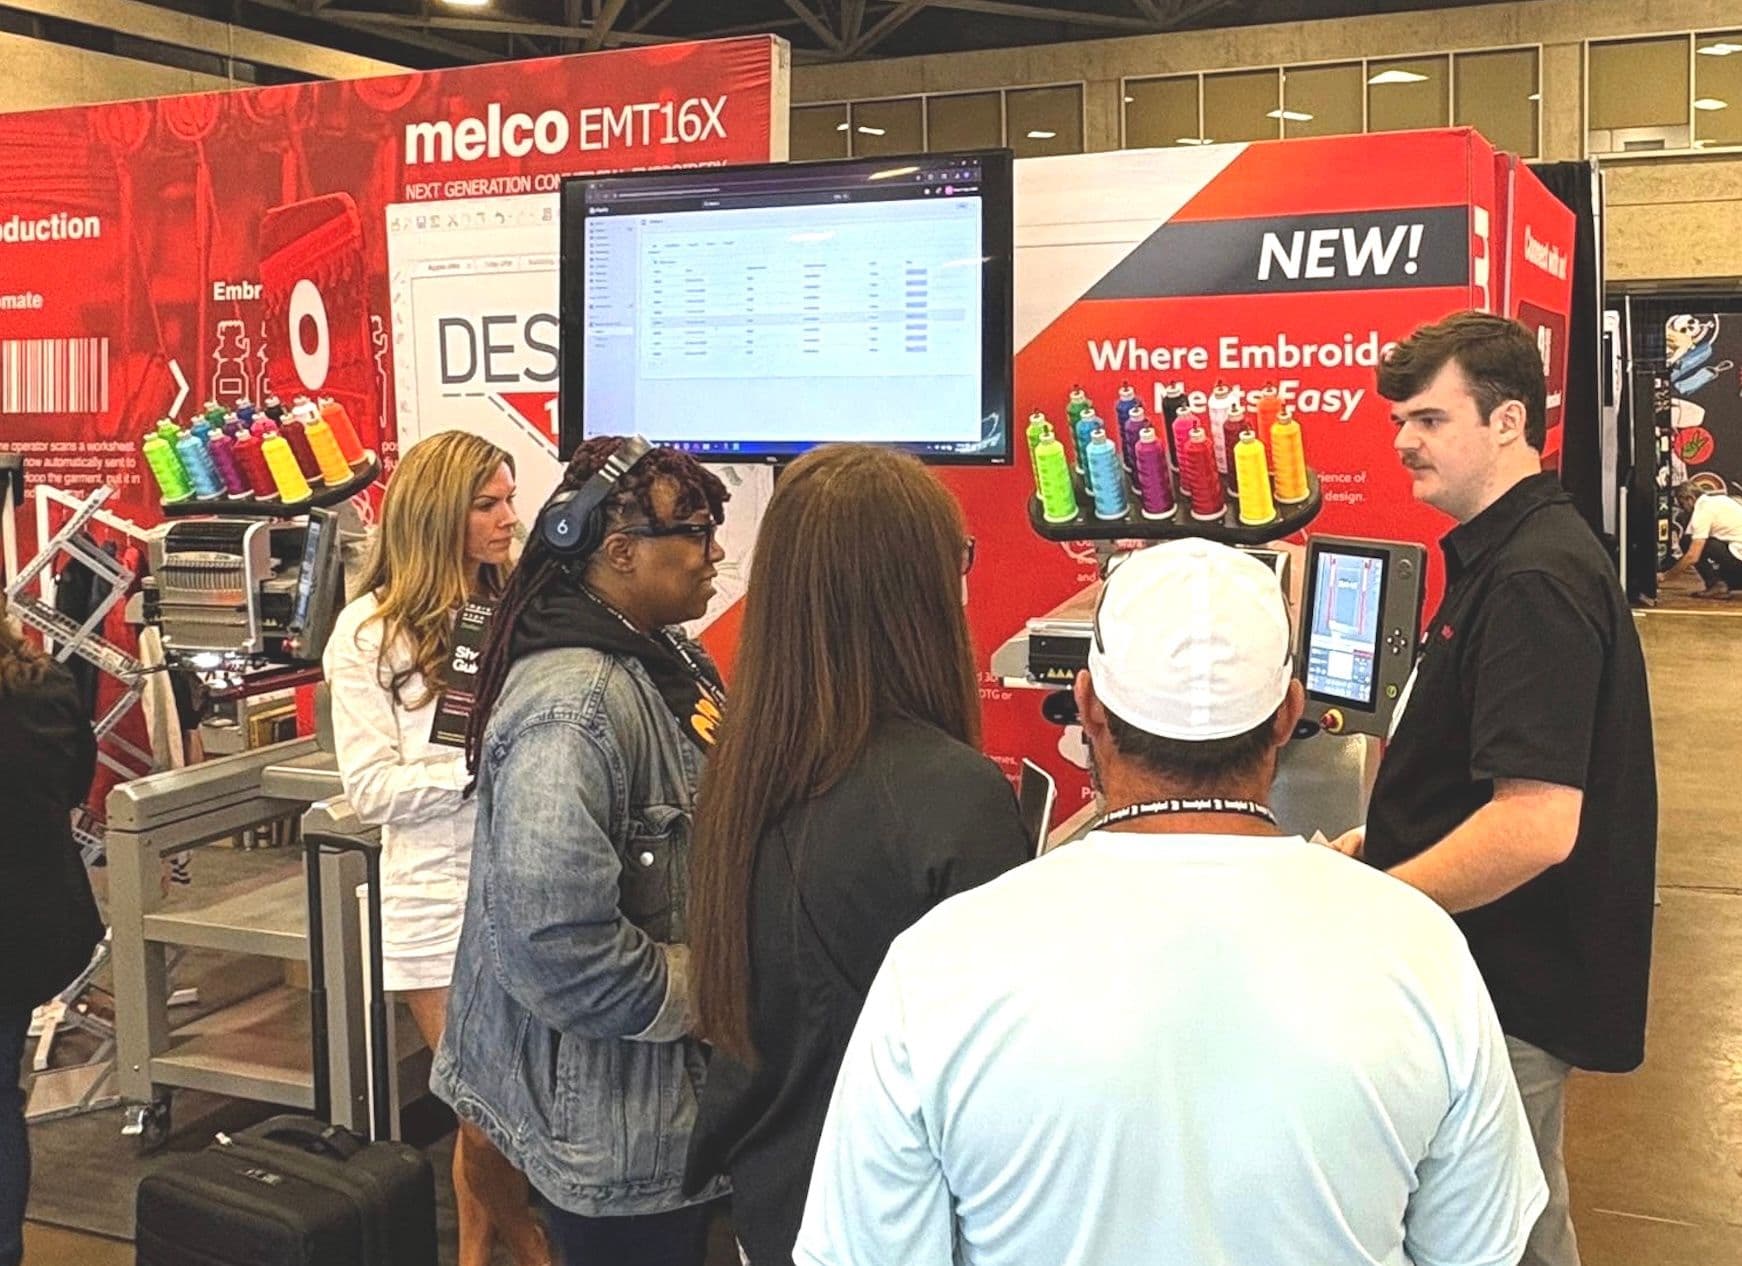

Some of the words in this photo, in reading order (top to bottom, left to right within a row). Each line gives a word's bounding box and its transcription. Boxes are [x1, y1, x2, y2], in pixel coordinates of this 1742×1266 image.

[405, 102, 568, 165] melco
[579, 95, 728, 151] EMT16X
[405, 183, 440, 201] NEXT
[444, 174, 531, 198] GENERATION
[0, 212, 101, 243] duction
[1257, 224, 1424, 281] NEW!
[0, 291, 44, 310] mate
[213, 280, 263, 301] Embr
[1088, 338, 1209, 371] Where
[1153, 381, 1264, 414] Mets
[1278, 379, 1366, 422] Easy
